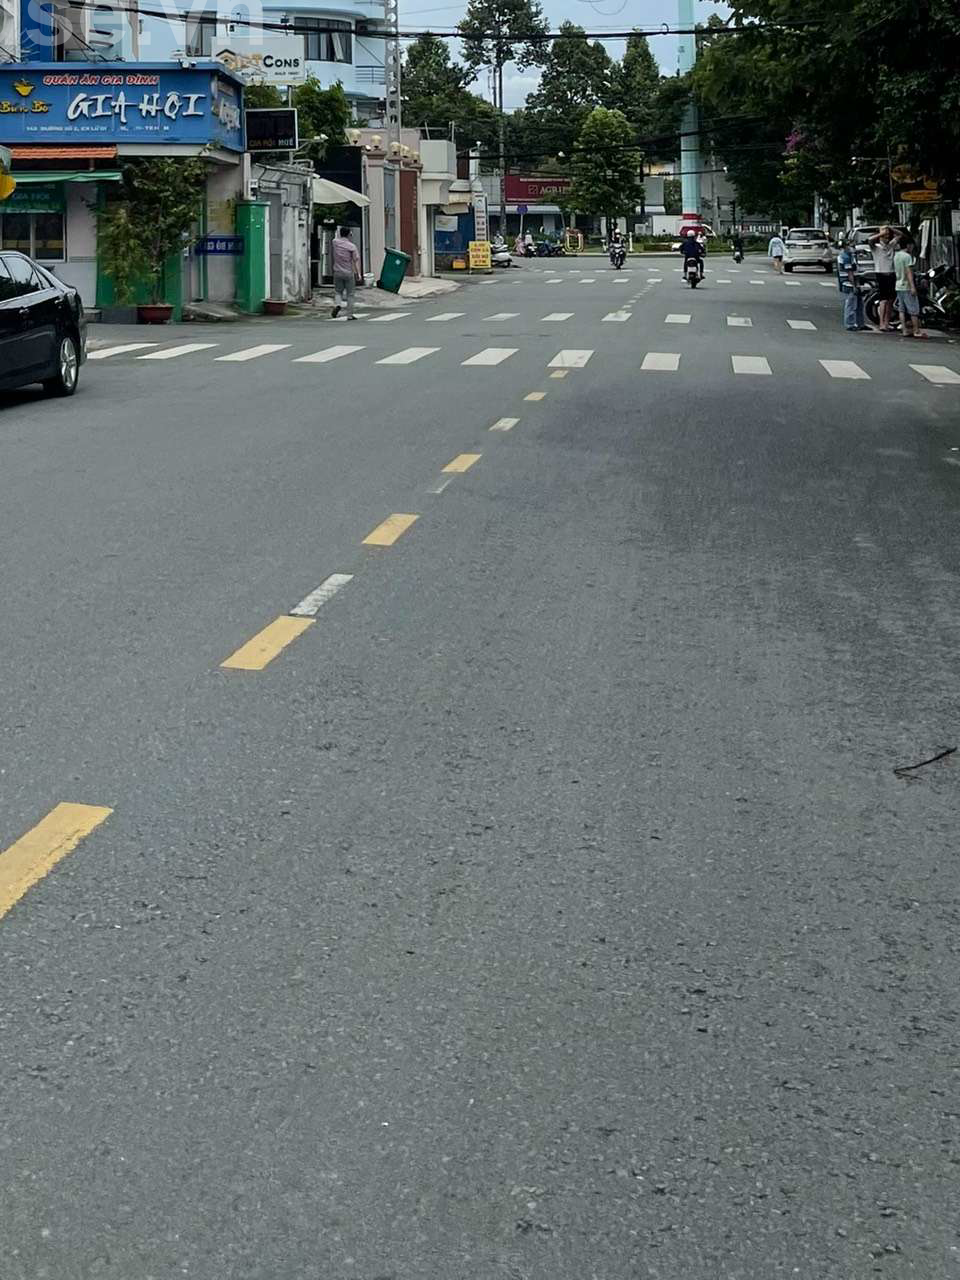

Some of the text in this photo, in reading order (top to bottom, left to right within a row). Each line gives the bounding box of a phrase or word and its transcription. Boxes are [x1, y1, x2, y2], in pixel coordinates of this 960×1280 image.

[43, 73, 160, 85] QUÁN ĂN GIA ĐÌNH
[67, 91, 136, 123] GIA
[139, 91, 207, 120] HỘI
